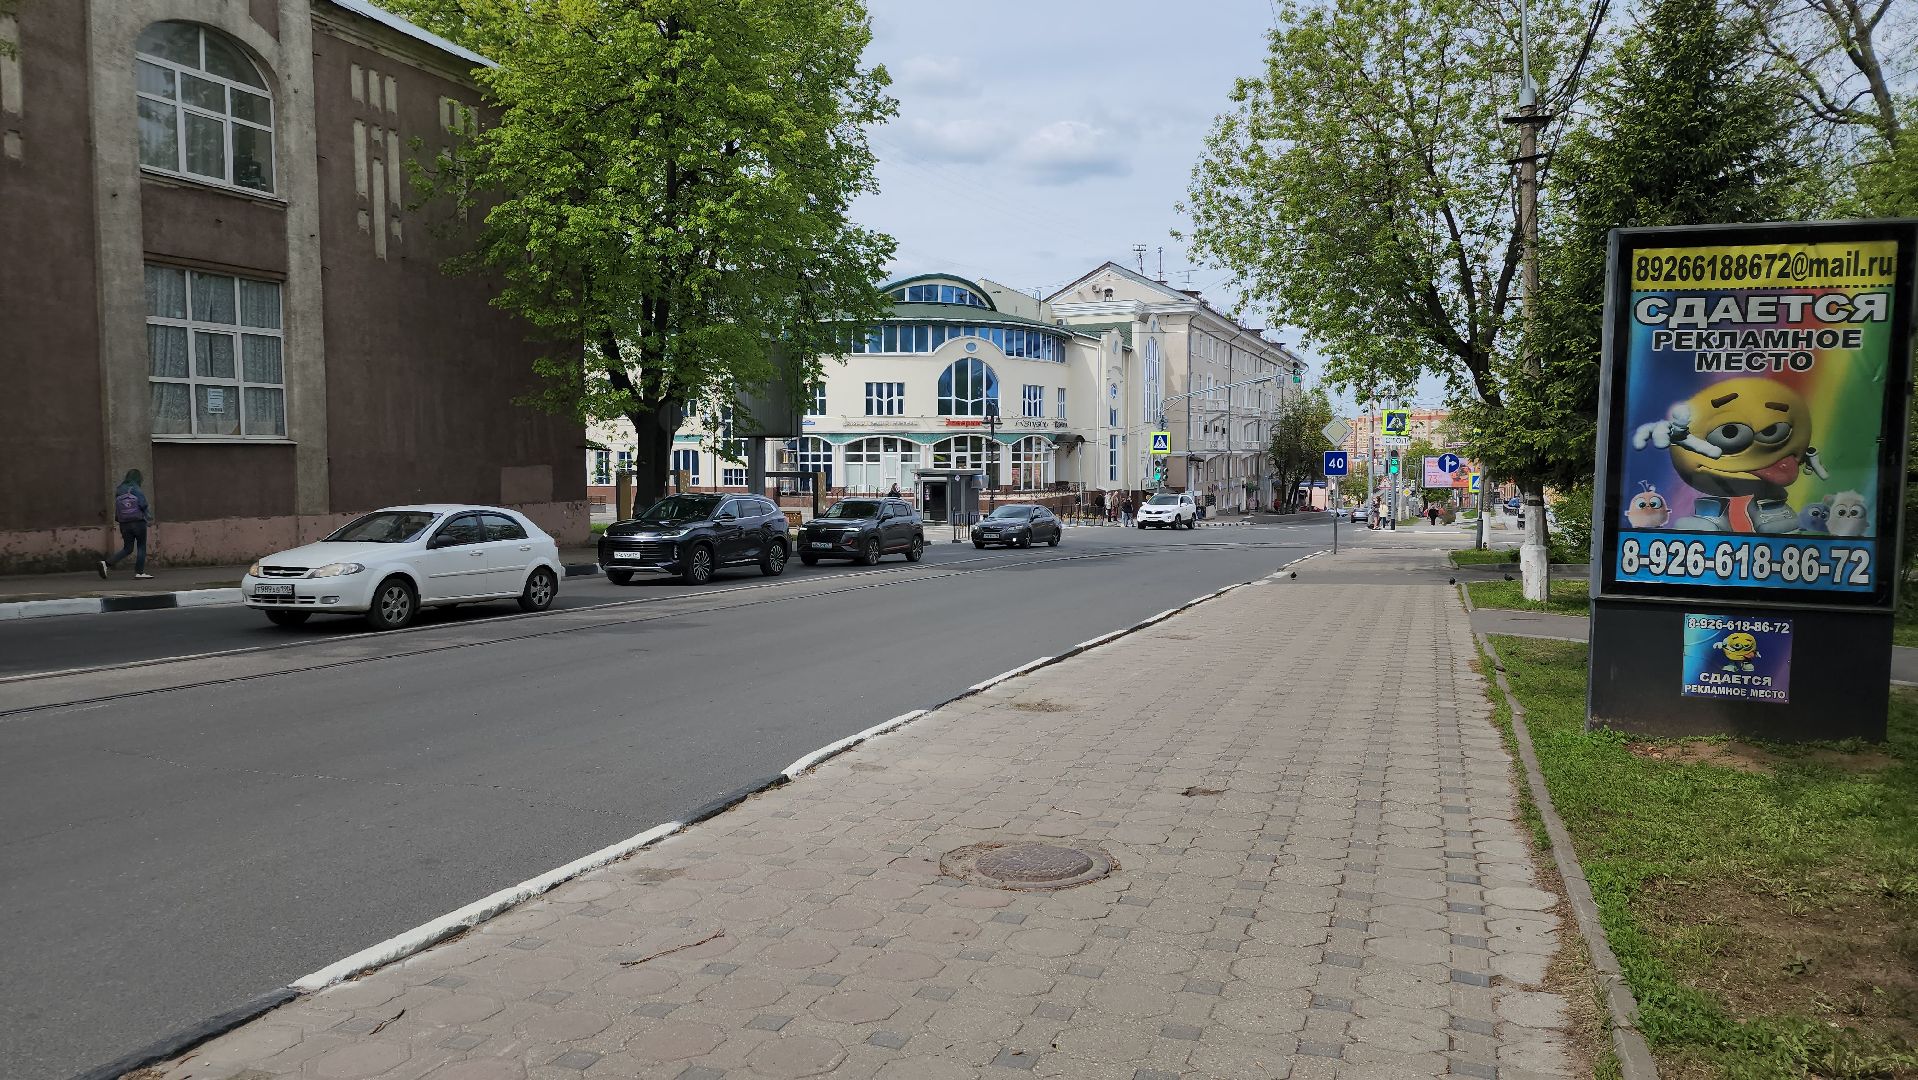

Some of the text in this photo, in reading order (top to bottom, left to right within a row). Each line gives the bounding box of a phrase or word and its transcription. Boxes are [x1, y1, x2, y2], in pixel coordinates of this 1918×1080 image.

[1635, 251, 1893, 282] 89266188672@mail.ru
[1634, 293, 1889, 330] СДАЕТСЯ
[1653, 329, 1864, 351] РЕКЛАМНОЕ
[1695, 351, 1815, 372] МЕСТО
[1328, 457, 1344, 469] 40
[1621, 538, 1871, 585] 8-926-618-86-72
[1687, 617, 1790, 634] 8-926-618-86-72
[1699, 672, 1773, 687] СДАЕТСЯ
[1684, 684, 1787, 700] РЕКЛАМНОЕ МЕСТО
